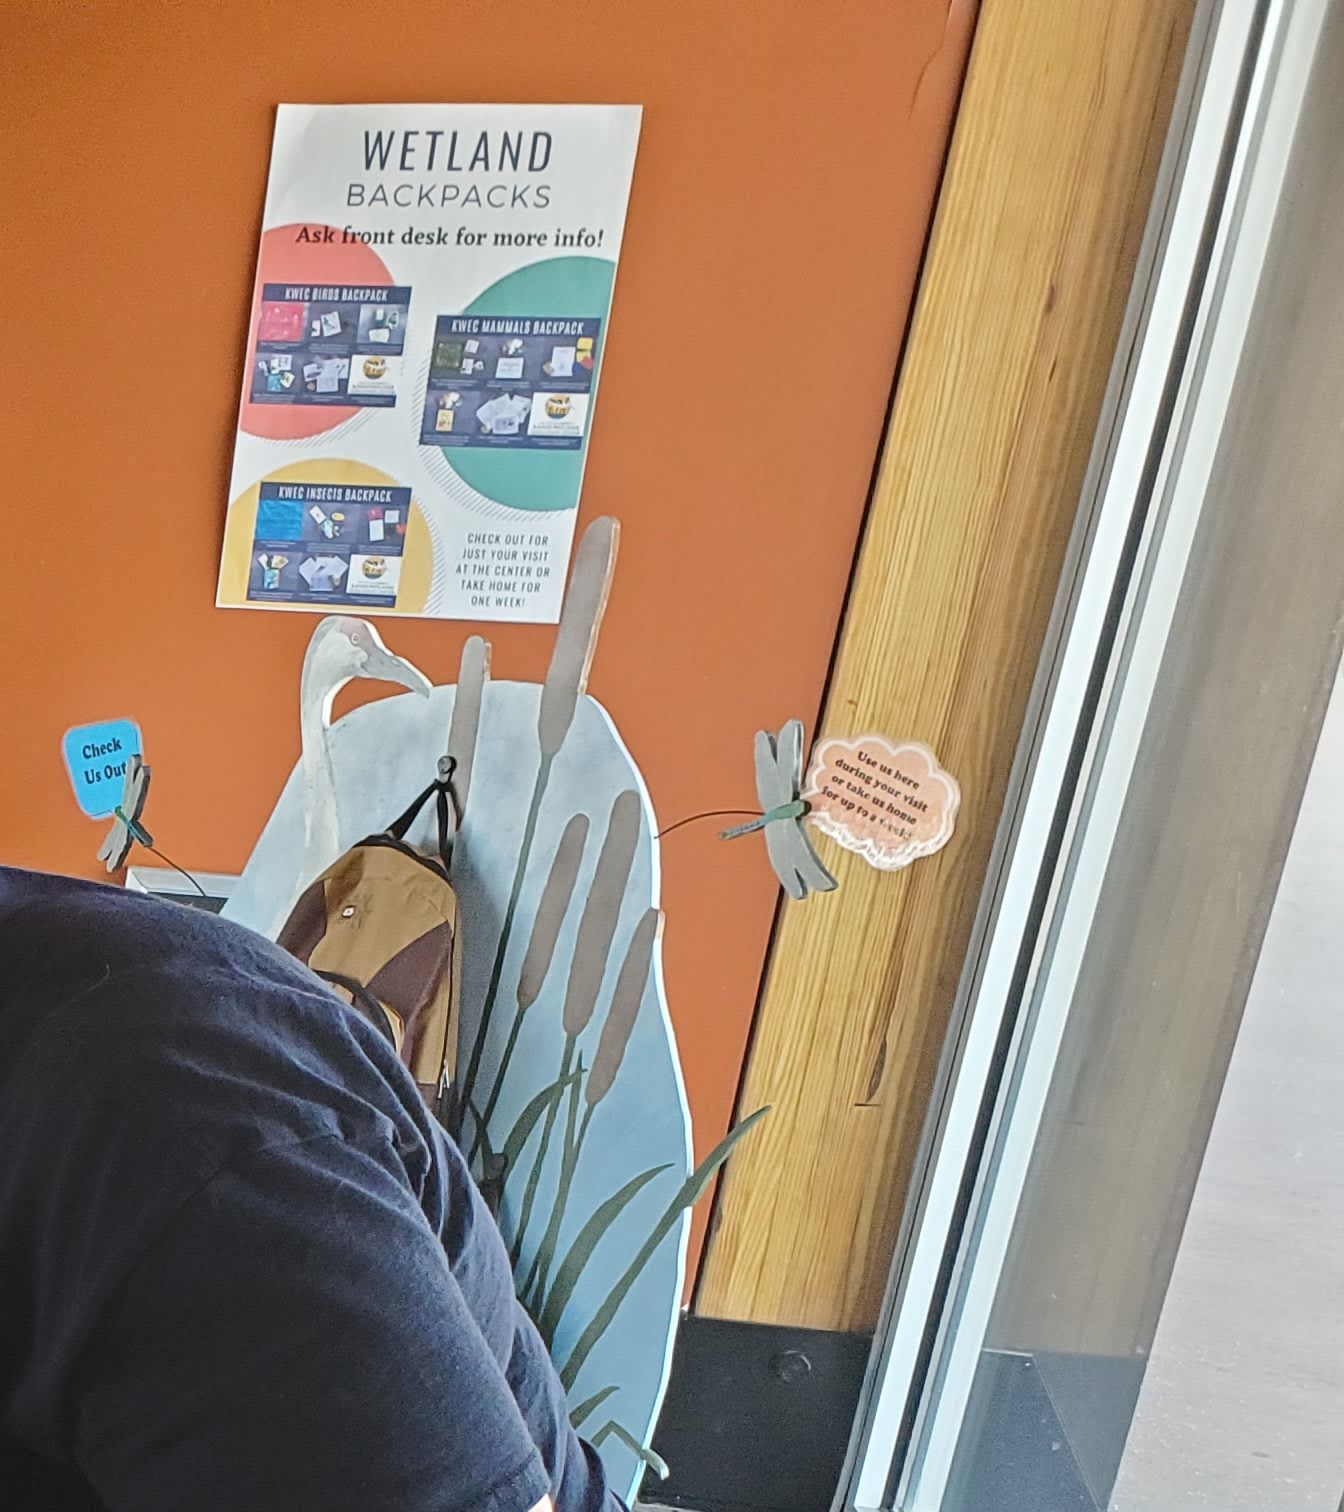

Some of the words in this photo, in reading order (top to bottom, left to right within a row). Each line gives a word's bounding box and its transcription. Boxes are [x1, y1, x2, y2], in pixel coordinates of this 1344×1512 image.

[363, 130, 553, 172] WETLAND
[346, 183, 552, 209] BACKPACKS
[295, 226, 335, 244] Ask
[341, 225, 394, 245] front
[401, 227, 448, 245] desk
[456, 227, 487, 247] for
[493, 231, 548, 248] more
[554, 228, 604, 248] info!
[481, 320, 531, 334] MAMMALS
[532, 321, 585, 335] BACKPACK
[344, 489, 393, 503] BACKPACK
[467, 532, 501, 546] CHECK
[504, 534, 526, 546] OUT
[528, 535, 549, 547] FOR
[462, 547, 487, 560] JUST
[491, 549, 519, 561] YOUR
[522, 549, 549, 562] VISIT
[456, 563, 470, 575] AT
[472, 564, 492, 576] THE
[494, 565, 534, 577] CENTER
[536, 566, 551, 578] OR
[460, 580, 486, 592] TAKE
[488, 580, 518, 592] HOME
[520, 580, 541, 593] FOR
[470, 595, 492, 607] ONE
[495, 595, 526, 608] WEEK!
[82, 737, 122, 760] Check
[84, 769, 102, 784] Us
[104, 762, 127, 780] Out
[857, 750, 878, 768] Use
[879, 763, 893, 774] us
[894, 769, 920, 789] here
[835, 758, 874, 786] during
[875, 780, 902, 799] your
[904, 793, 929, 813] visit
[821, 785, 840, 801] for
[840, 797, 855, 812] up
[857, 805, 869, 817] to
[831, 774, 846, 786] or
[847, 779, 871, 800] take
[872, 796, 886, 807] us
[887, 803, 917, 826] home
